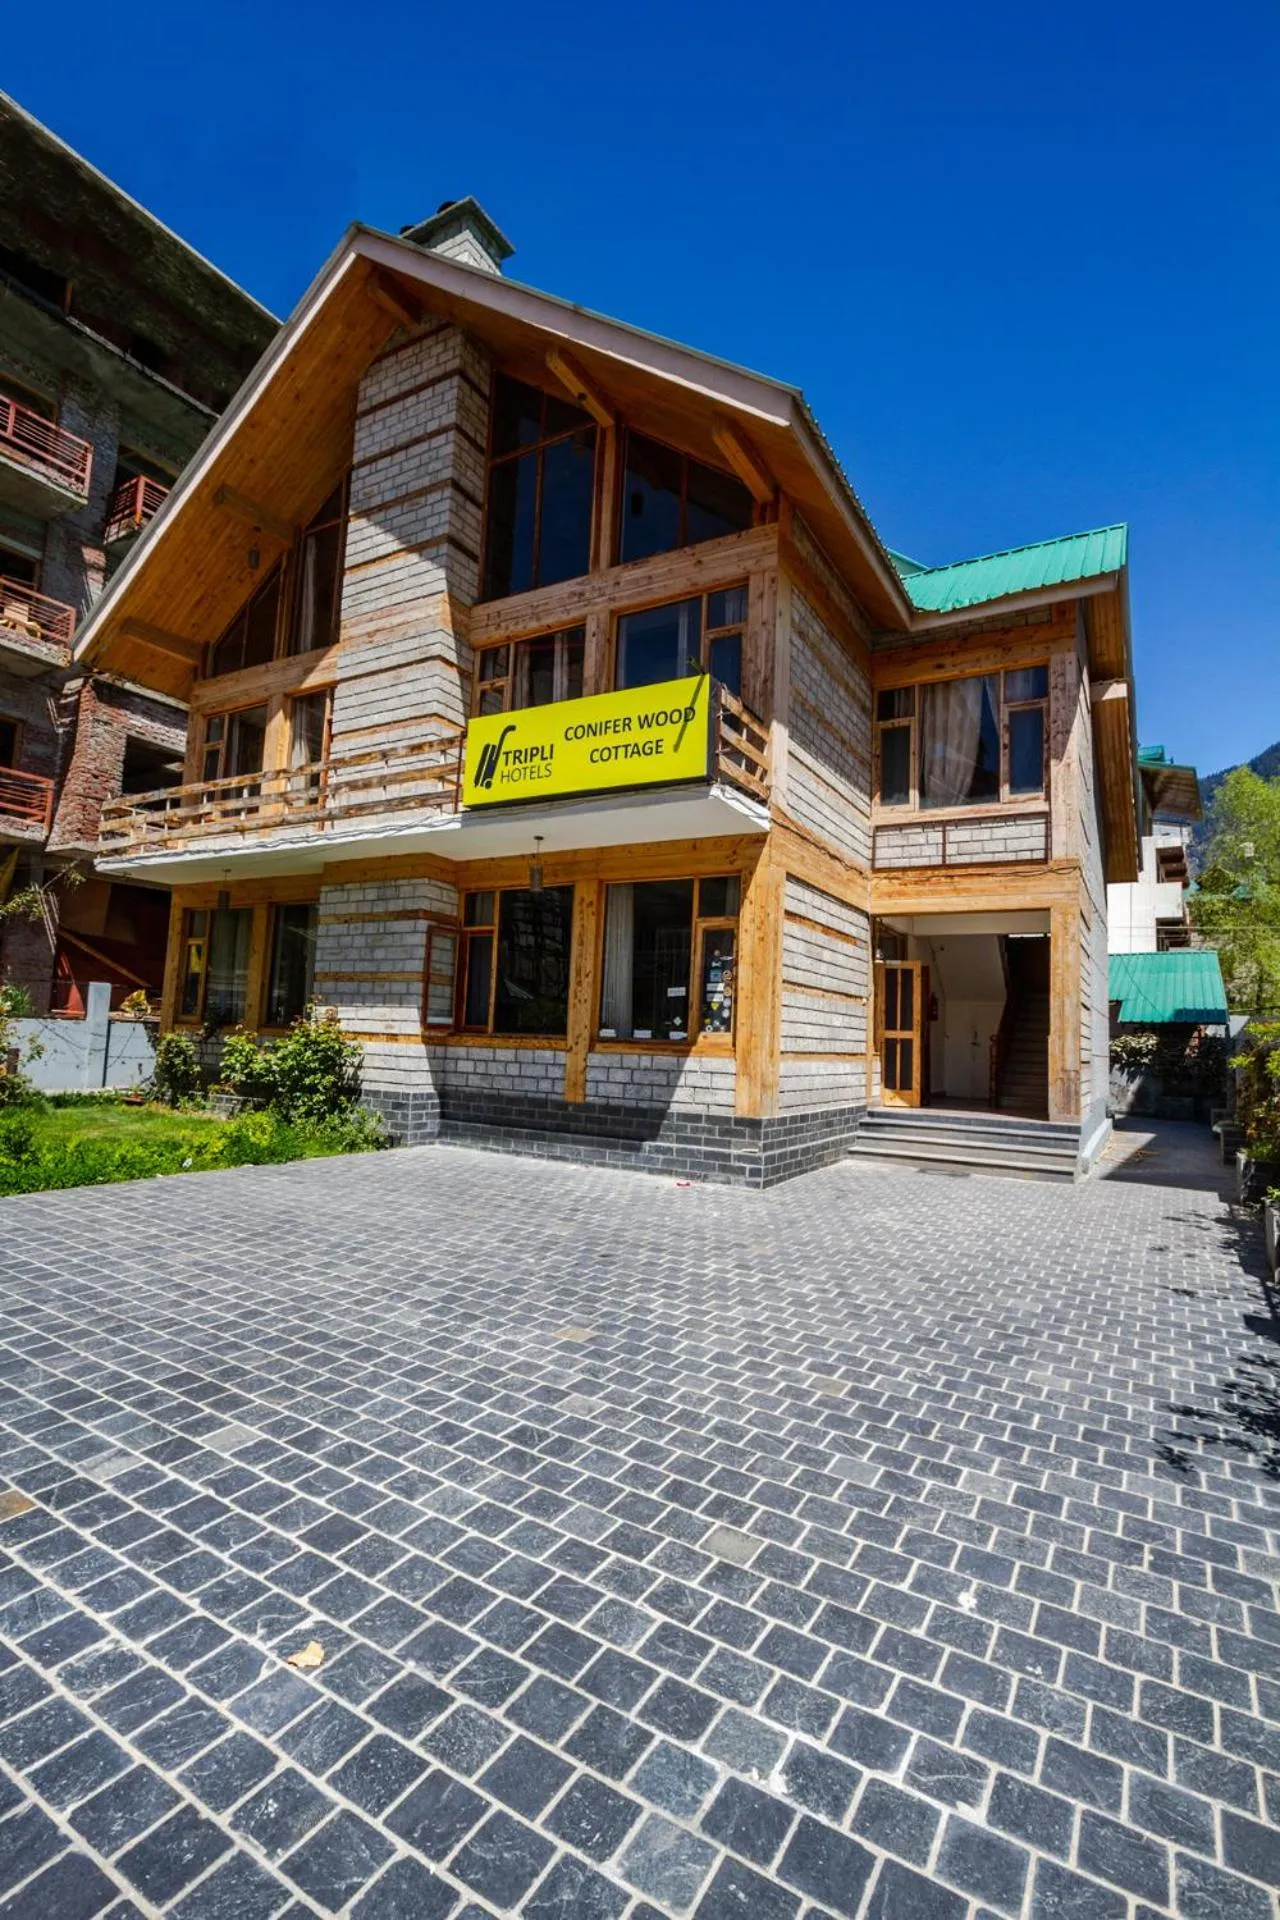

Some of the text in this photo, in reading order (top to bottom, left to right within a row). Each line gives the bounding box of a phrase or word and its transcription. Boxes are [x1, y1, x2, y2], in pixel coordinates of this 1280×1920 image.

[564, 706, 695, 741] CONIFER WOOD
[503, 744, 554, 766] TRIPLI
[589, 739, 664, 763] COTTAGE
[500, 763, 552, 784] HOTELS
